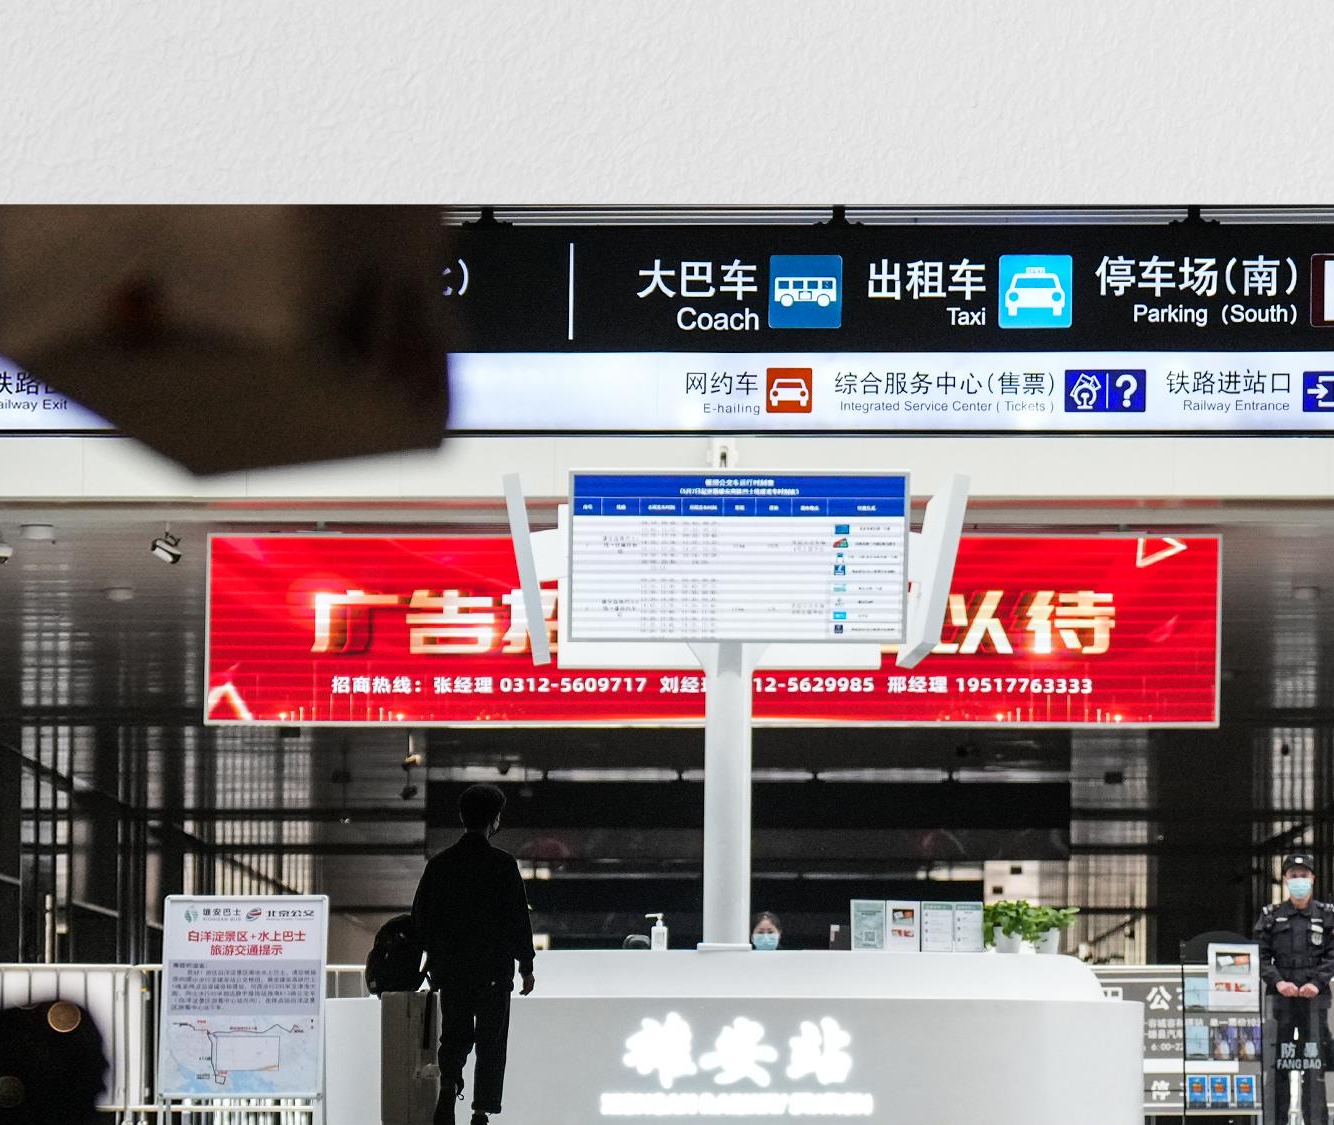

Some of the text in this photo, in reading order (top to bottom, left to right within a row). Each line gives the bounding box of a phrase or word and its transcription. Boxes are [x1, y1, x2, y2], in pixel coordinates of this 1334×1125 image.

[637, 259, 759, 300] 大巴车
[867, 258, 987, 300] 出租车
[1095, 255, 1298, 298] 停车场（南）
[676, 307, 760, 331] Coach
[946, 307, 986, 327] Taxi
[1133, 303, 1298, 328] Parking (South)
[685, 371, 759, 396] 网约车
[835, 371, 1055, 397] 综合服务中心（售票）
[1166, 369, 1291, 394] 铁路进站口
[42, 399, 68, 410] Exit
[703, 402, 761, 415] E-hailing
[840, 401, 899, 414] Integrated
[904, 401, 947, 412] Service
[952, 401, 992, 412] Center
[1183, 399, 1290, 414] Railway Entrance
[331, 676, 422, 695] 招商热线：
[433, 676, 494, 694] 张经理
[499, 677, 647, 693] 0312-5609717
[887, 676, 948, 694] 邢经理
[955, 677, 1094, 694] 19517763333
[203, 908, 241, 916] 雄安巴士
[188, 930, 306, 942] 白洋淀景区+水上巴士
[211, 944, 283, 956] 旅游交通提示
[1281, 1042, 1318, 1058] 防暴
[1277, 1059, 1321, 1069] FANG BAO
